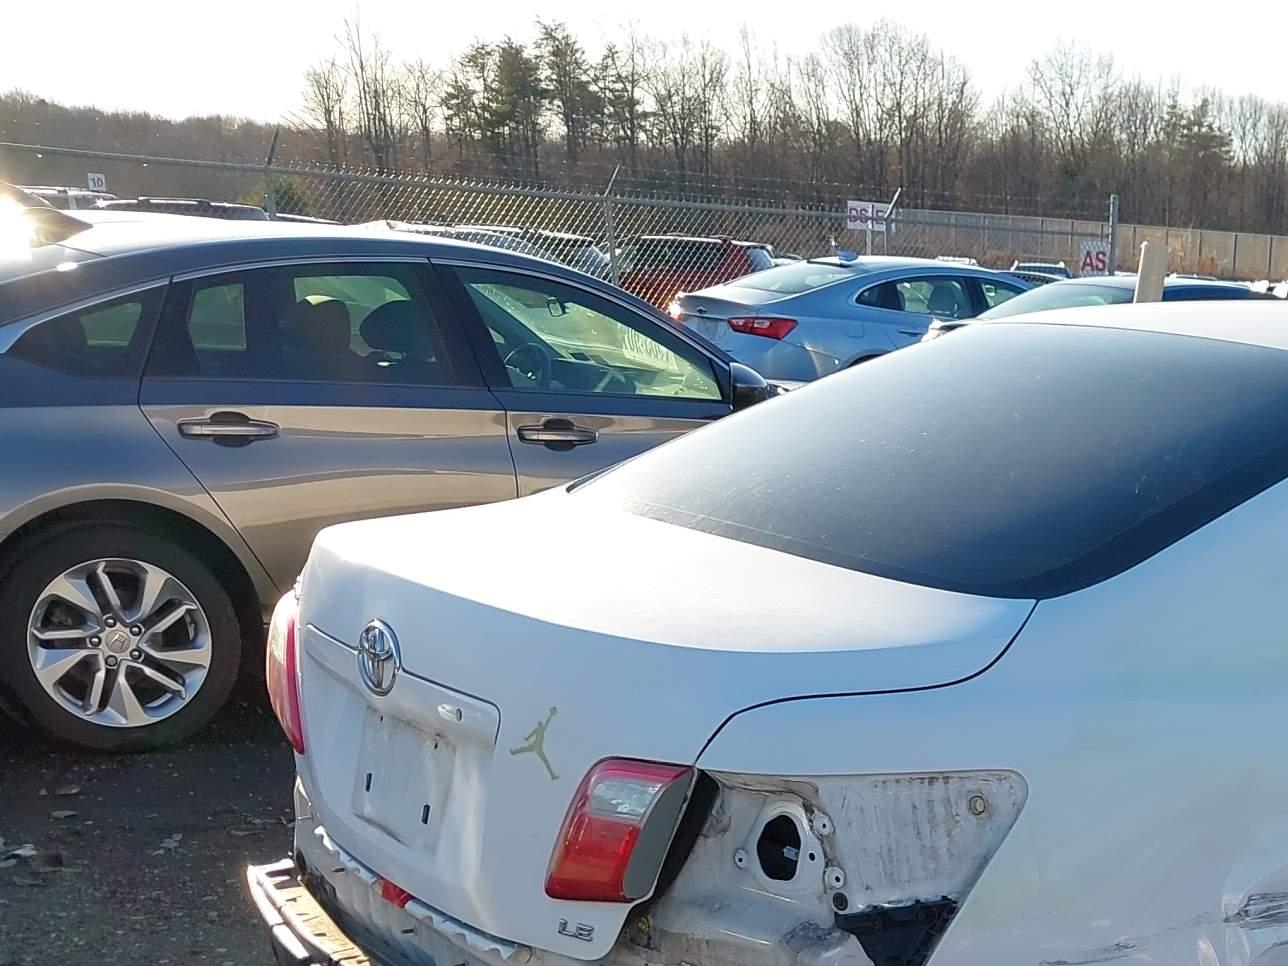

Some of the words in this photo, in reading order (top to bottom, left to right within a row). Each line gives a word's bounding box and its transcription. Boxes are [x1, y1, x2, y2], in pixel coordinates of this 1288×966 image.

[90, 177, 104, 188] 10
[1081, 250, 1106, 272] AS
[558, 918, 595, 942] LE
